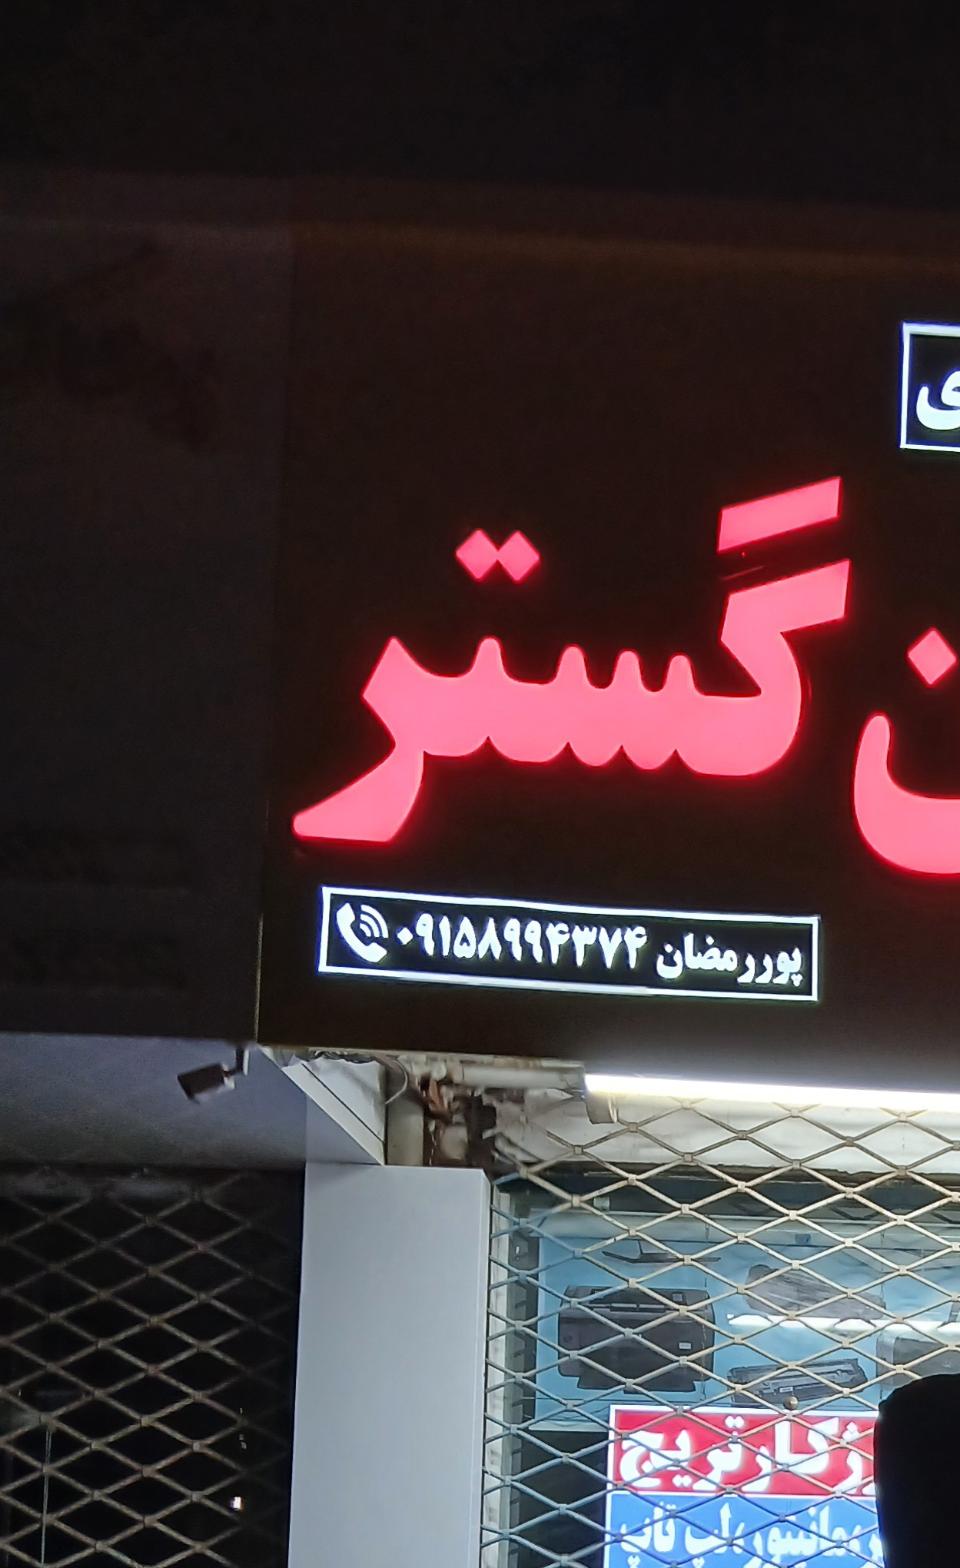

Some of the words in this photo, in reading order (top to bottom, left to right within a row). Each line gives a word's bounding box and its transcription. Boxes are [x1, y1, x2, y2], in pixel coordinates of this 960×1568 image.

[292, 475, 852, 843] گستر
[397, 912, 648, 970] ۰۹۱۵۸۹۹۴۳۷۴
[619, 1415, 839, 1493] کارتریج
